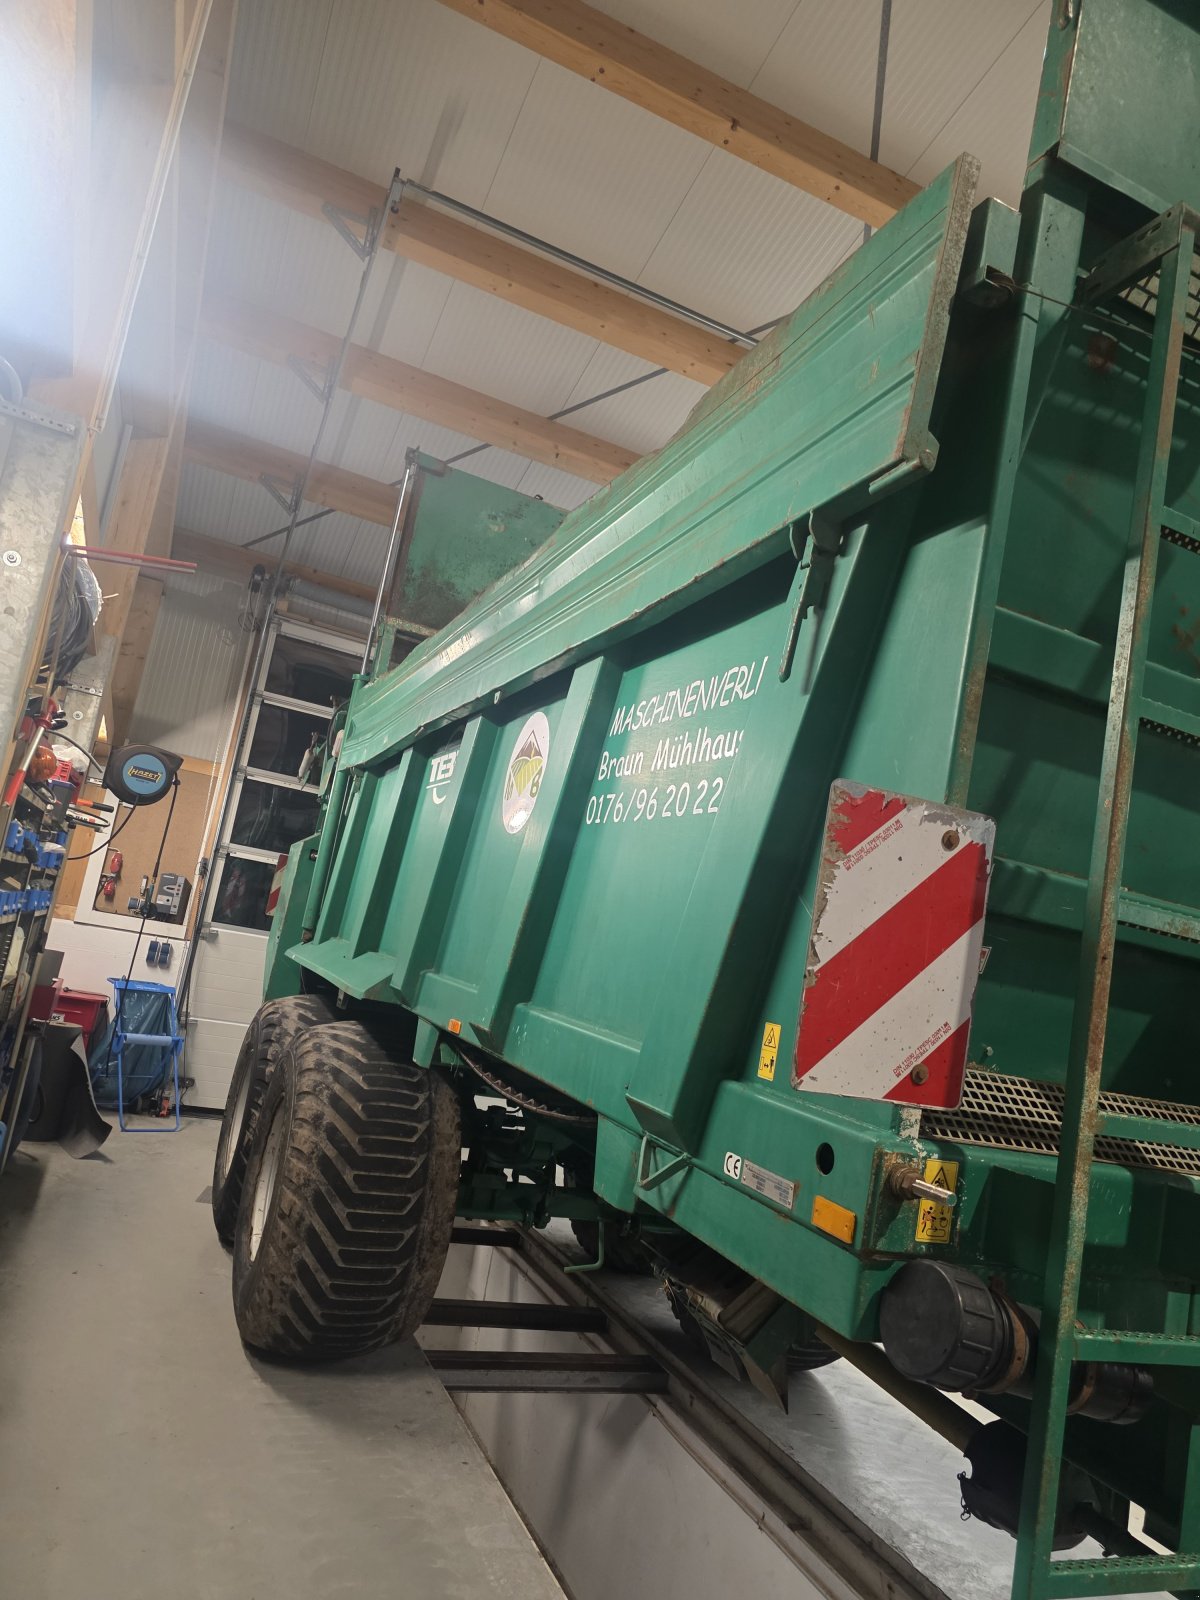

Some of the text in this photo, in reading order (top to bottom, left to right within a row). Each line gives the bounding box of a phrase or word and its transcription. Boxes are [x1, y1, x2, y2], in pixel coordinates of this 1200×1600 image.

[130, 767, 159, 781] HAZET
[598, 751, 644, 781] Braun
[725, 1154, 741, 1178] CE
